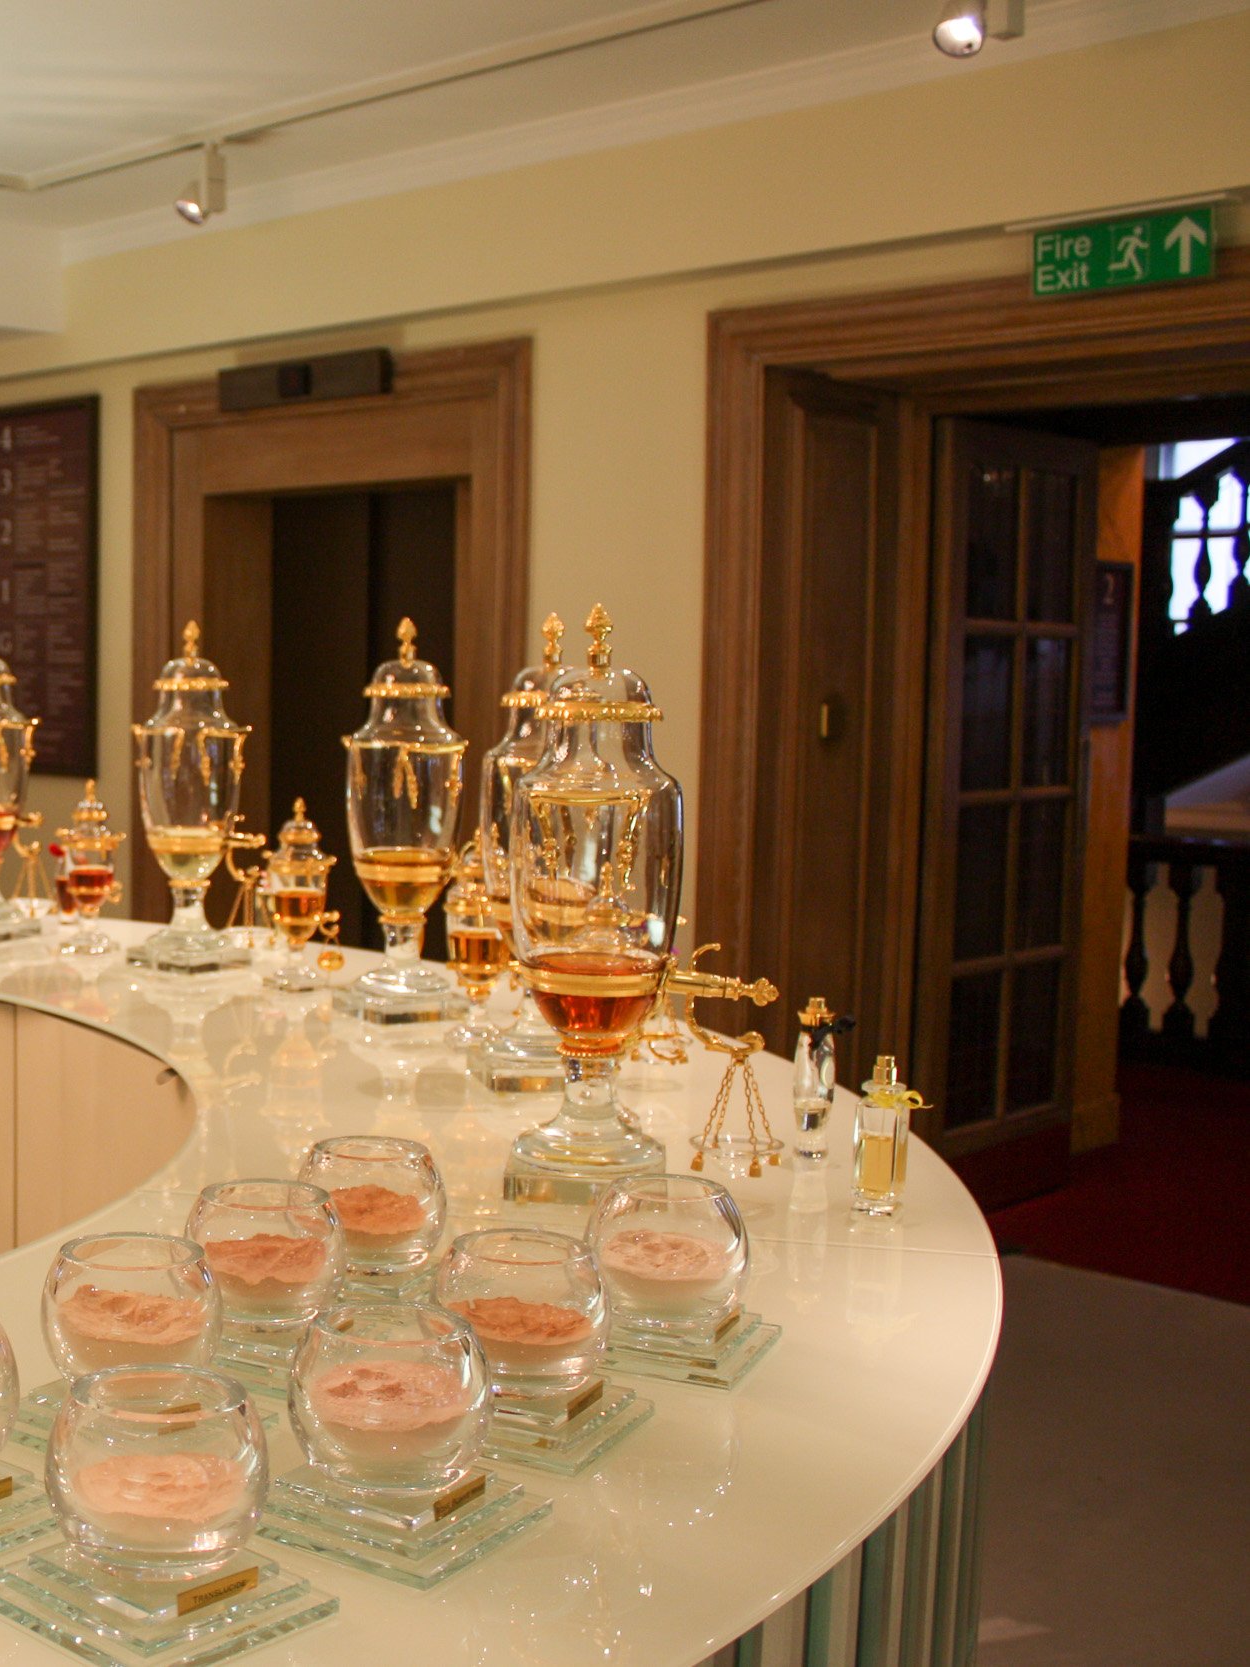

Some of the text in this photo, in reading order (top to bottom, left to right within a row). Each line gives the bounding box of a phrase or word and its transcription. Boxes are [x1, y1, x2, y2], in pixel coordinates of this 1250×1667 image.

[1036, 234, 1092, 262] Fire
[1036, 263, 1090, 292] Exit
[0, 426, 12, 451] 4
[0, 469, 12, 494] 3
[0, 520, 12, 546] 2
[192, 1580, 248, 1604] TRANSLUCIDE
